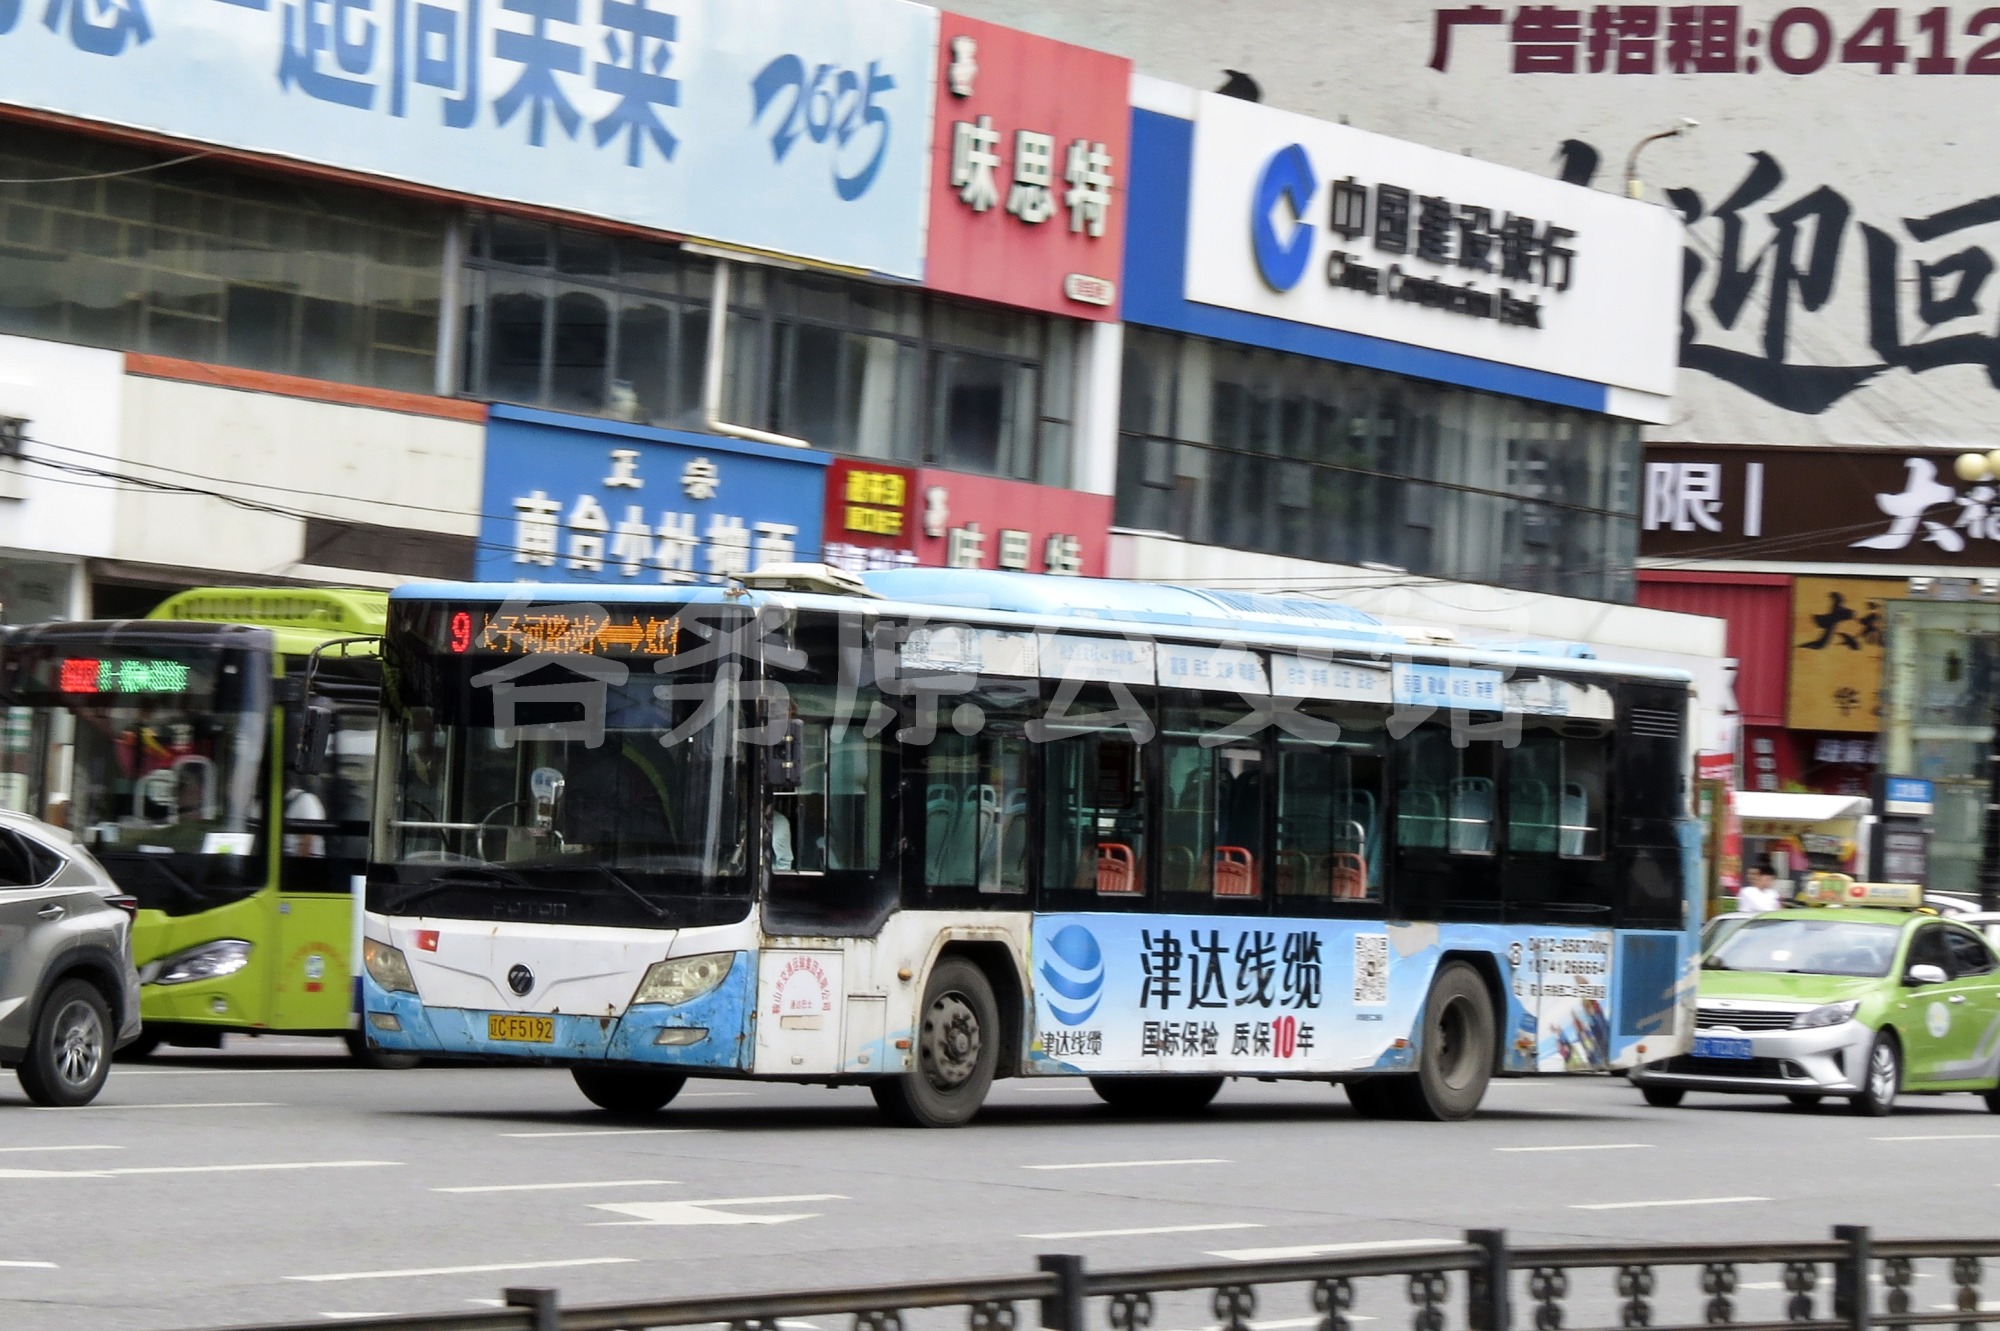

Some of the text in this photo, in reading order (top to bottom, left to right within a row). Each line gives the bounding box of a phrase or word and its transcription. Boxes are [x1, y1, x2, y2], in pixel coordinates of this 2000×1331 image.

[950, 114, 1114, 238] 味思特
[1330, 175, 1578, 292] 中国建设银行
[451, 612, 472, 653] 9
[1139, 928, 1323, 1010] 津达线缆
[1040, 1030, 1103, 1057] 津达线缆
[1142, 1015, 1315, 1059] 国标保检 质保10年
